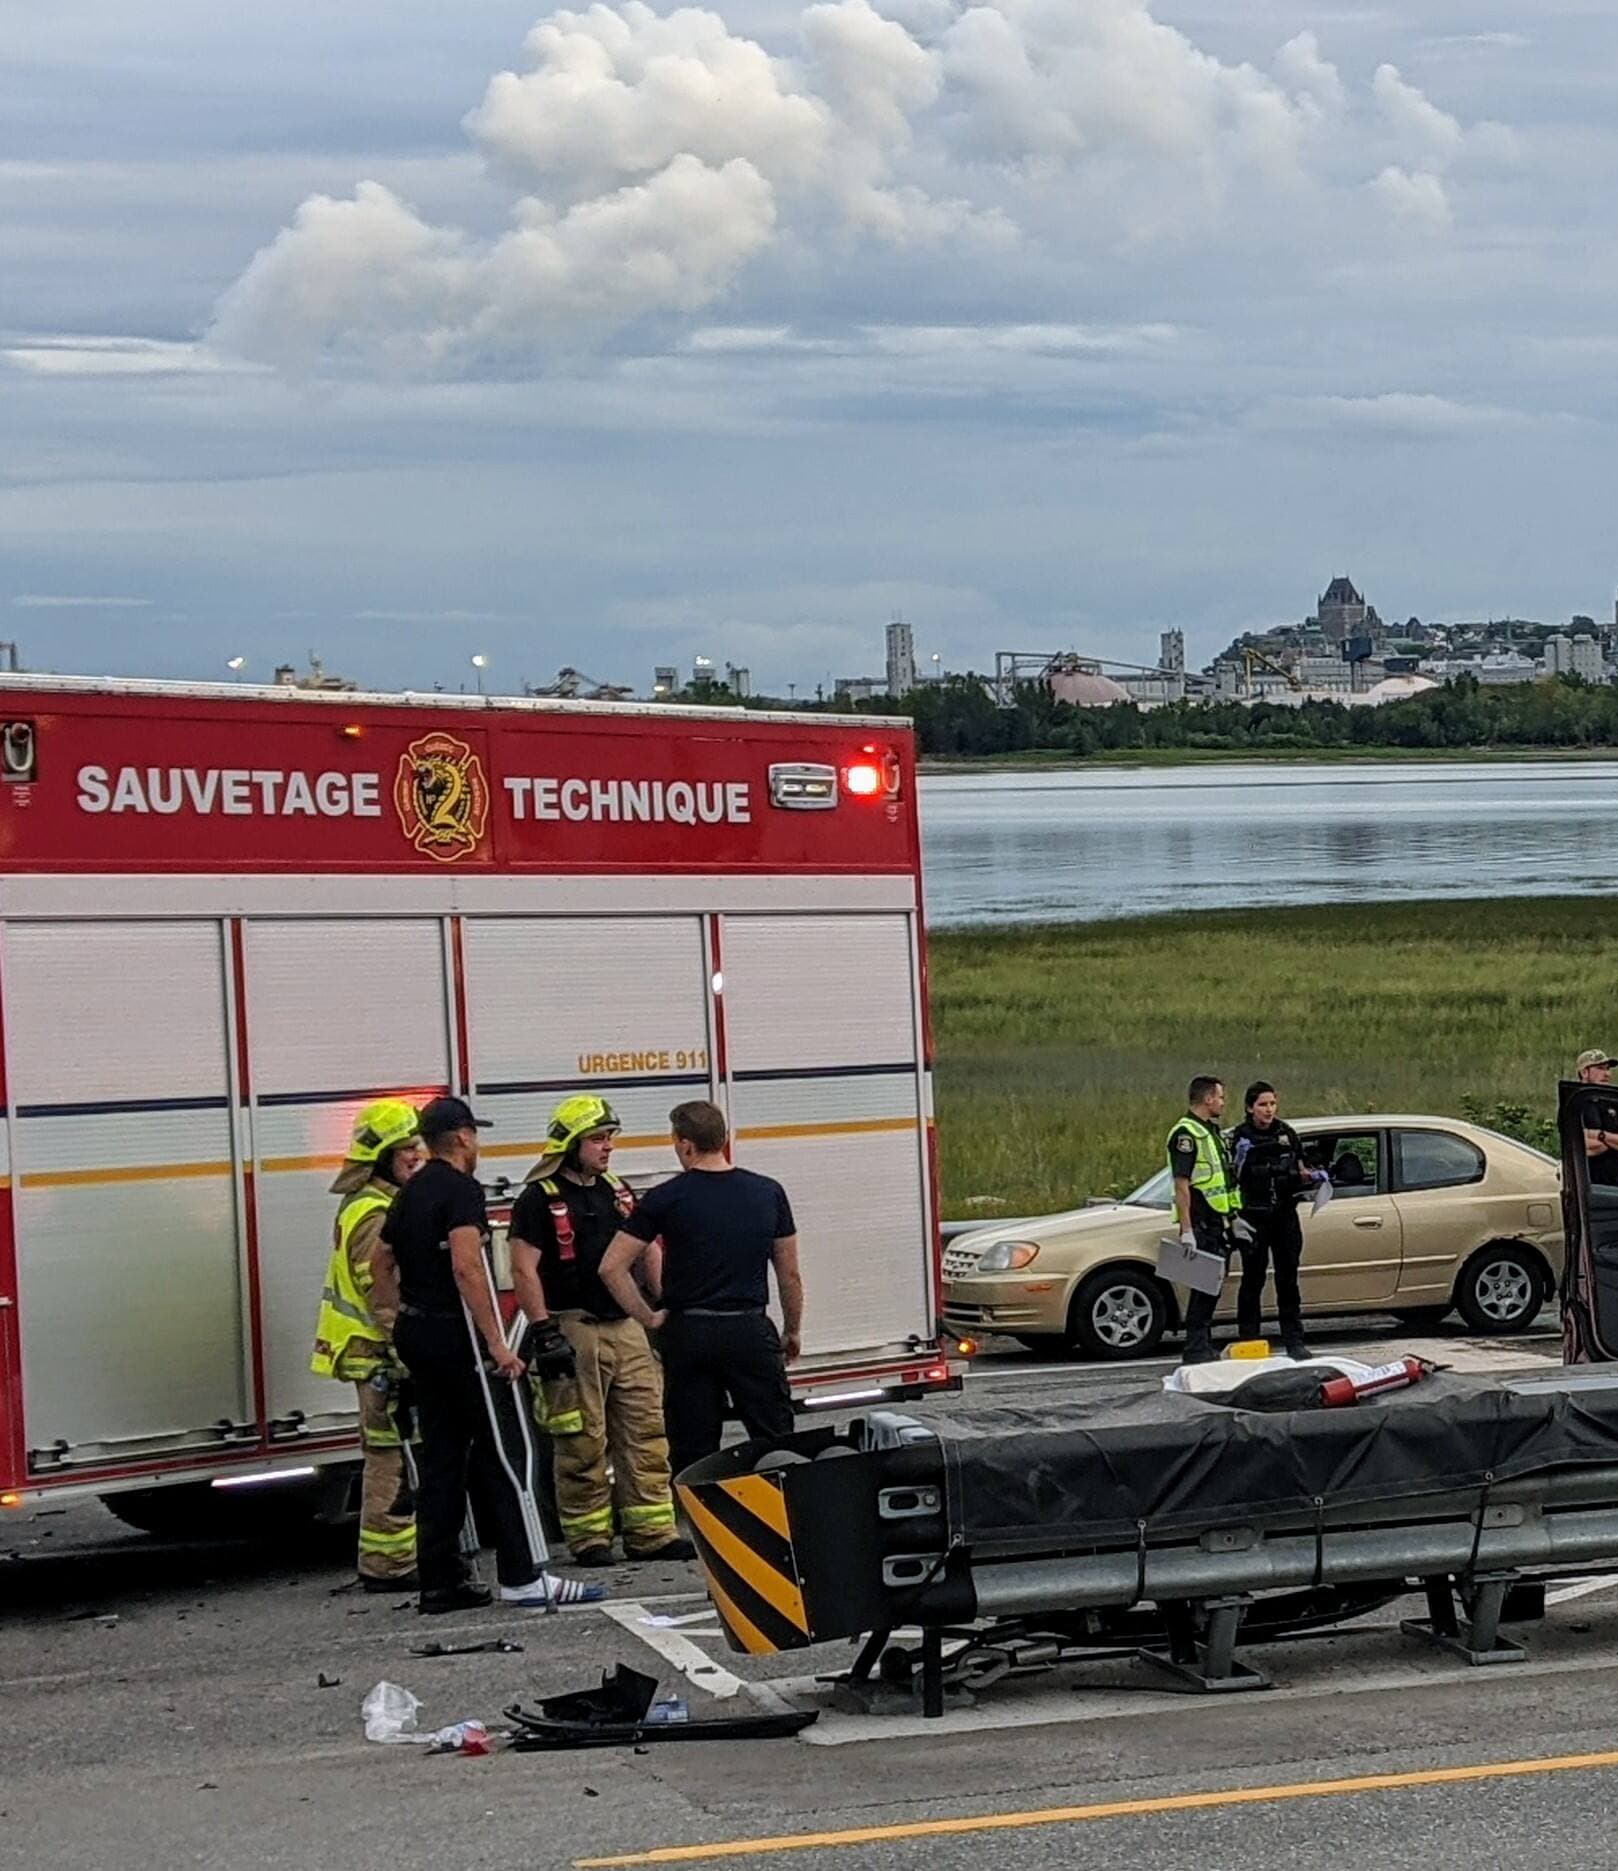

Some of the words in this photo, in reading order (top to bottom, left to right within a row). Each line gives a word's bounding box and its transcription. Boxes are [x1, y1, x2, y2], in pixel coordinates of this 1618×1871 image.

[76, 765, 382, 817] SAUVETAGE
[503, 777, 751, 826] TECHNIQUE
[578, 1050, 670, 1074] URGENCE
[676, 1049, 707, 1070] 911
